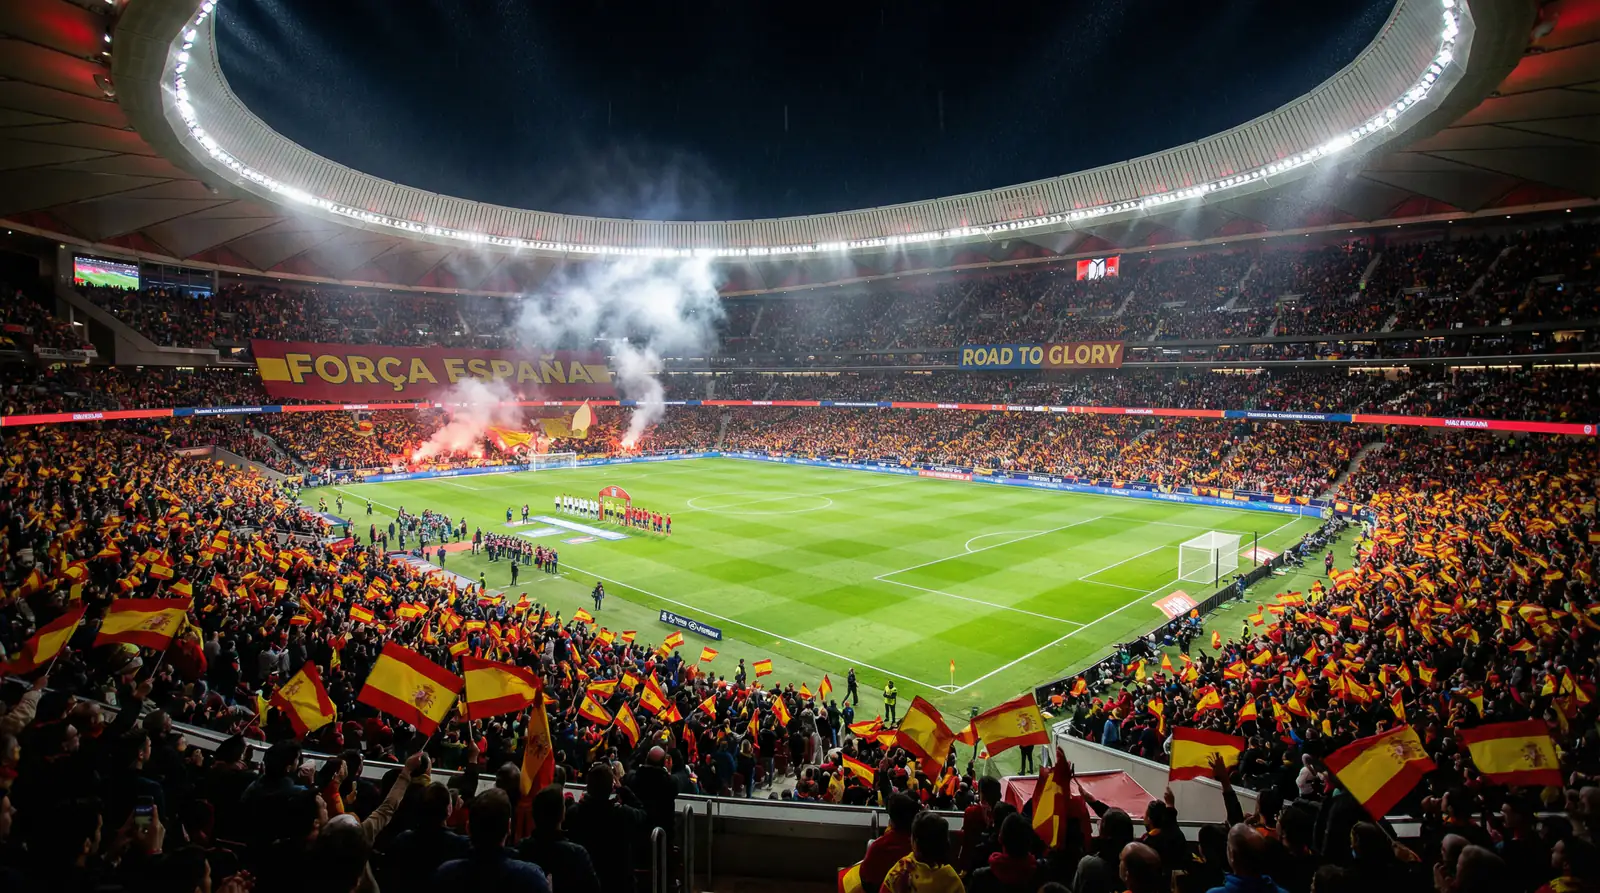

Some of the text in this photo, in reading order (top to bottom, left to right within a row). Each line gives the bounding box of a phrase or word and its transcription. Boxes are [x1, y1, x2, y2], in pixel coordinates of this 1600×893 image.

[962, 344, 1121, 366] ROAD TO GLORY
[285, 353, 594, 391] FORÇA ESPAÑA
